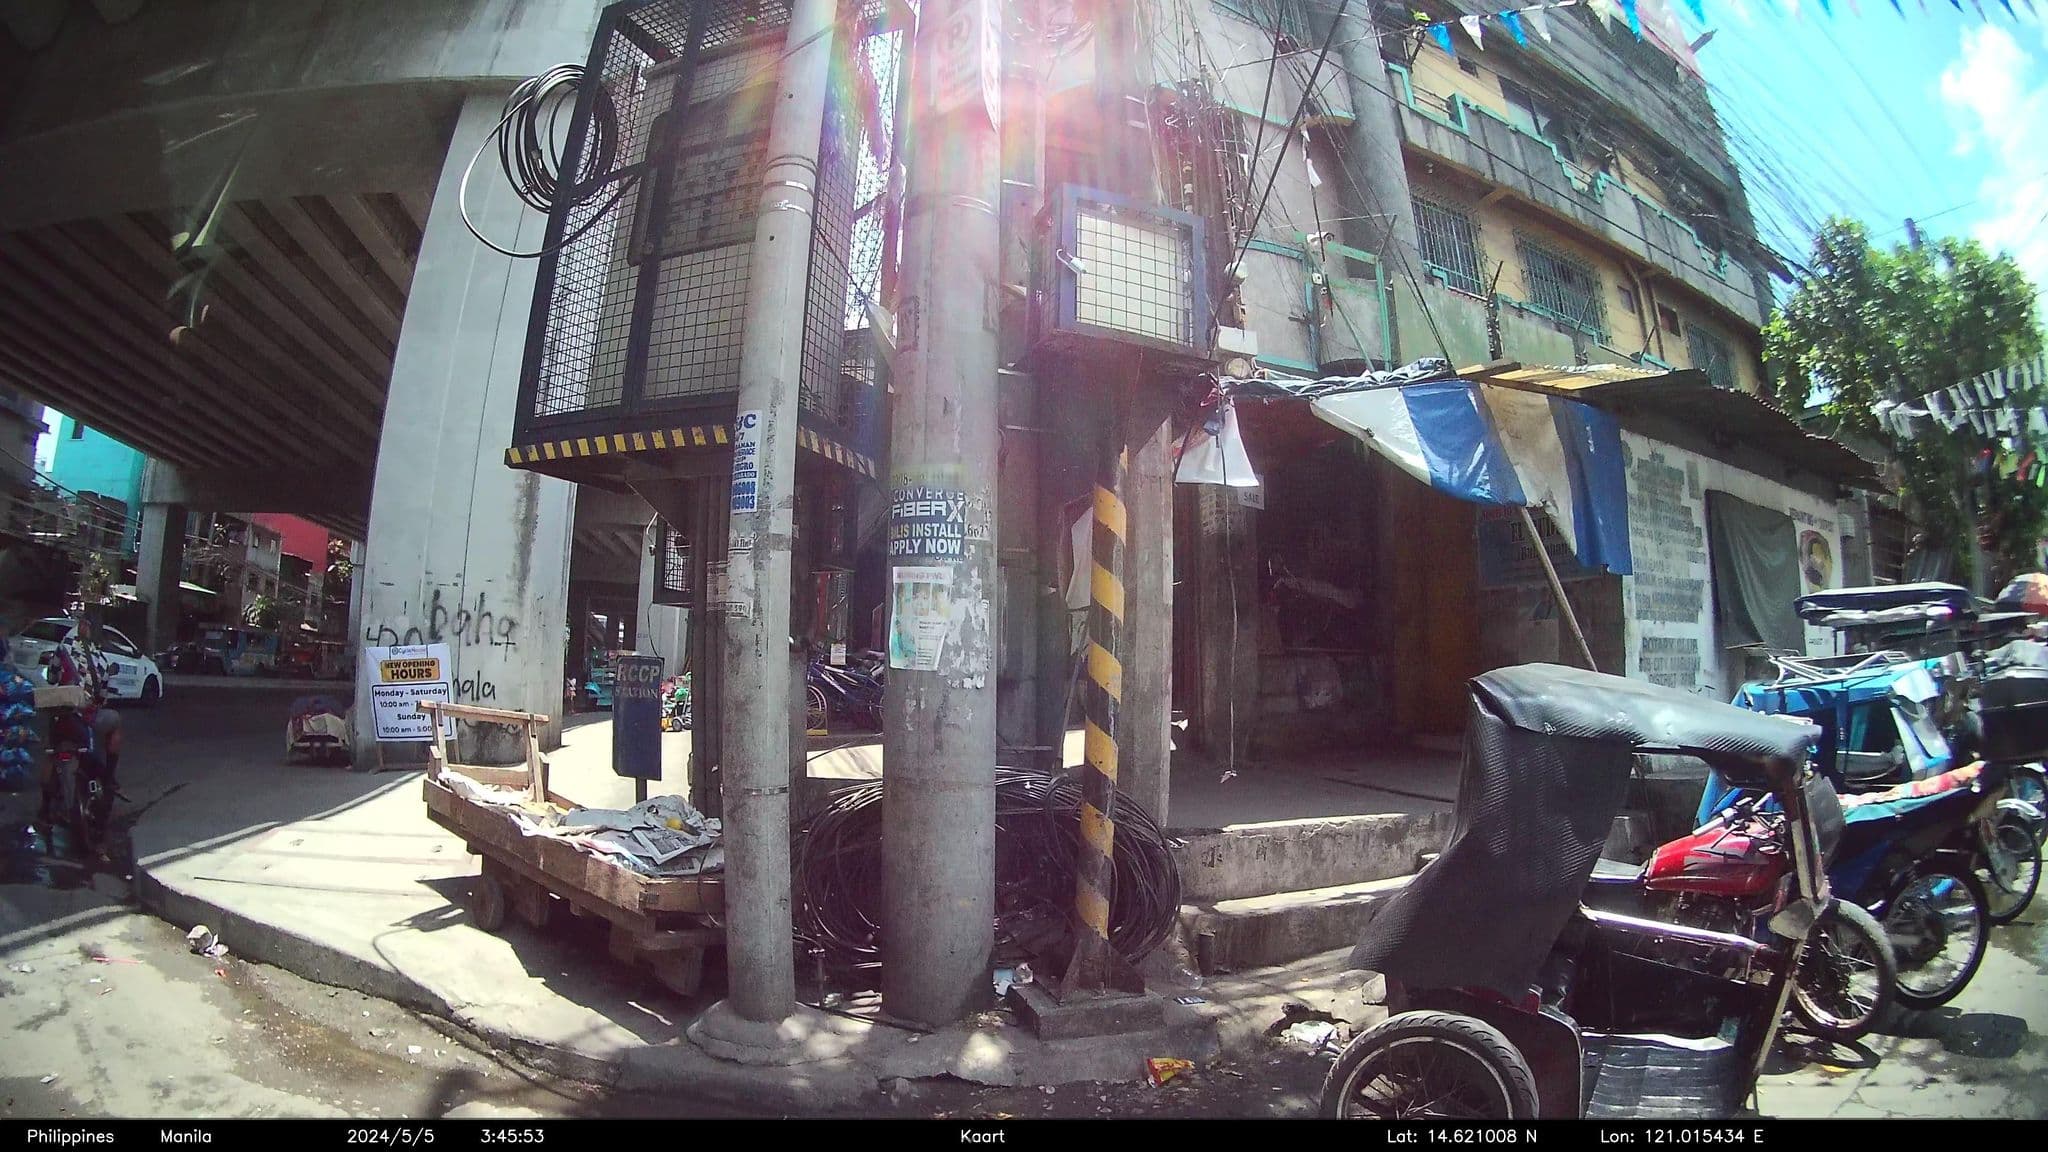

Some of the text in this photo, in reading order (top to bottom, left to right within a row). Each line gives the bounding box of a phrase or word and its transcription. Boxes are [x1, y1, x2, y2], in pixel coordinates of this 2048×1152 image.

[912, 522, 962, 538] INSTALL
[889, 538, 962, 555] APPLY NOW
[384, 659, 436, 669] NEW OPENING
[391, 668, 432, 680] HOURS
[374, 689, 404, 698] Monday
[410, 687, 447, 697] Saturday
[396, 713, 426, 721] Sunday
